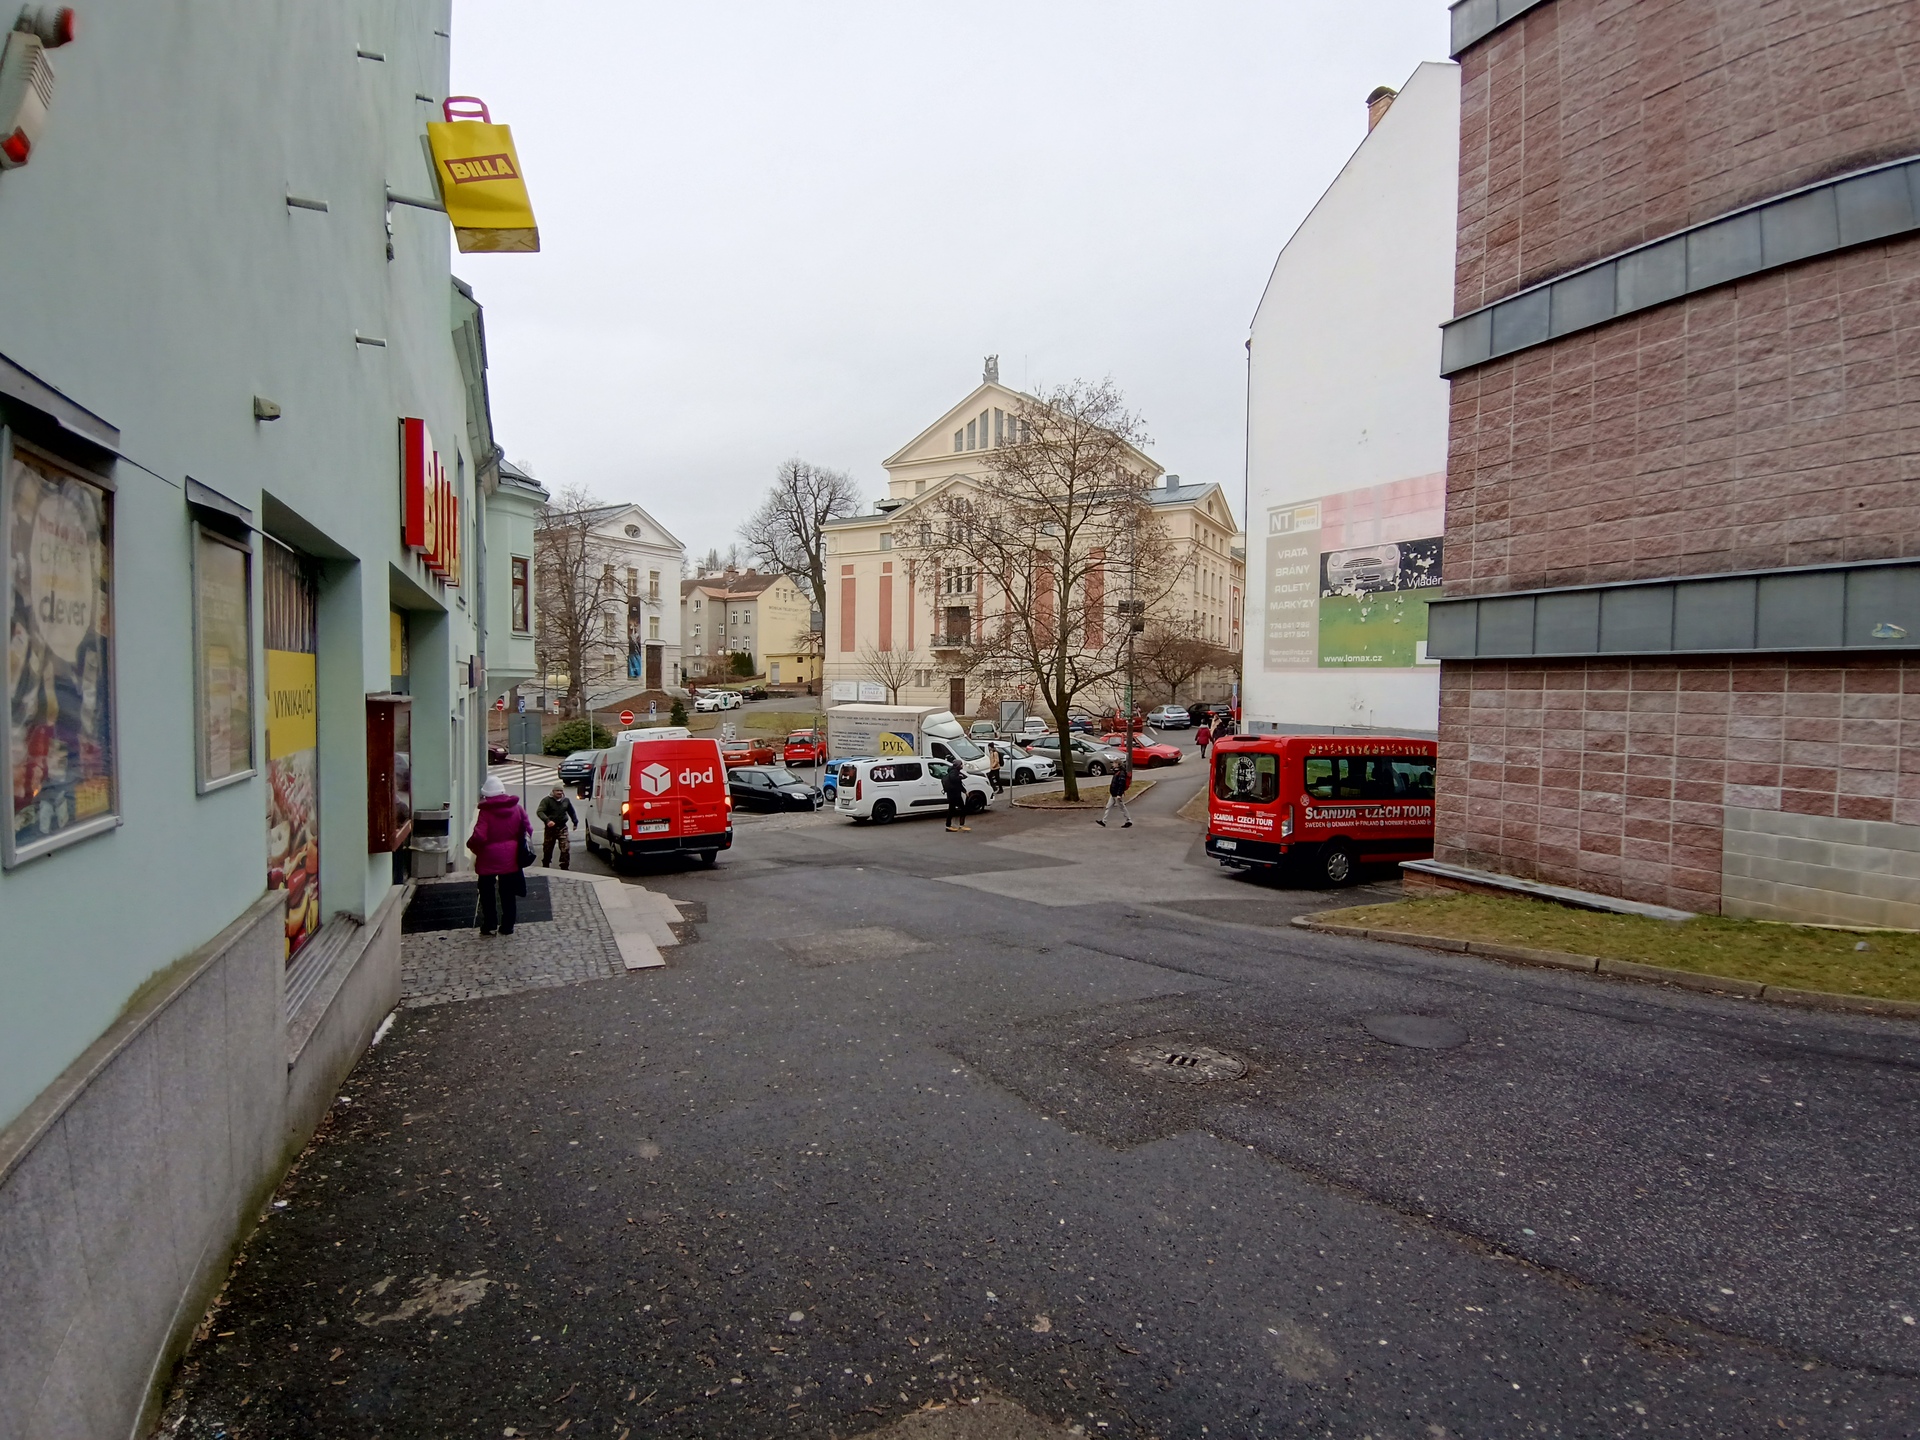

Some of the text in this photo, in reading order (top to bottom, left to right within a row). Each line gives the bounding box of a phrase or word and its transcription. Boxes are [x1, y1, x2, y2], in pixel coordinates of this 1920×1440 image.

[449, 158, 514, 180] BILLA
[1271, 512, 1292, 531] NT
[1295, 517, 1316, 529] group
[1277, 547, 1309, 559] VRATA
[1275, 563, 1311, 577] BRÁNY
[1274, 582, 1311, 593] ROLETY
[38, 590, 87, 627] clever
[1270, 597, 1316, 610] MARKÝZY
[1324, 654, 1383, 662] www.lomax.cz
[273, 683, 314, 720] VYNIKAJÍCÍ
[882, 740, 904, 752] PVK
[678, 766, 714, 789] dpd
[1364, 805, 1401, 818] CZECH
[1402, 805, 1432, 818] TOUR
[1213, 813, 1234, 822] SCANDIA
[1237, 815, 1255, 825] CZECH
[1255, 817, 1273, 827] TOUR
[1304, 820, 1326, 829] SWEDEN
[1331, 820, 1355, 828] DENMARK
[1359, 819, 1380, 827] FINLAND
